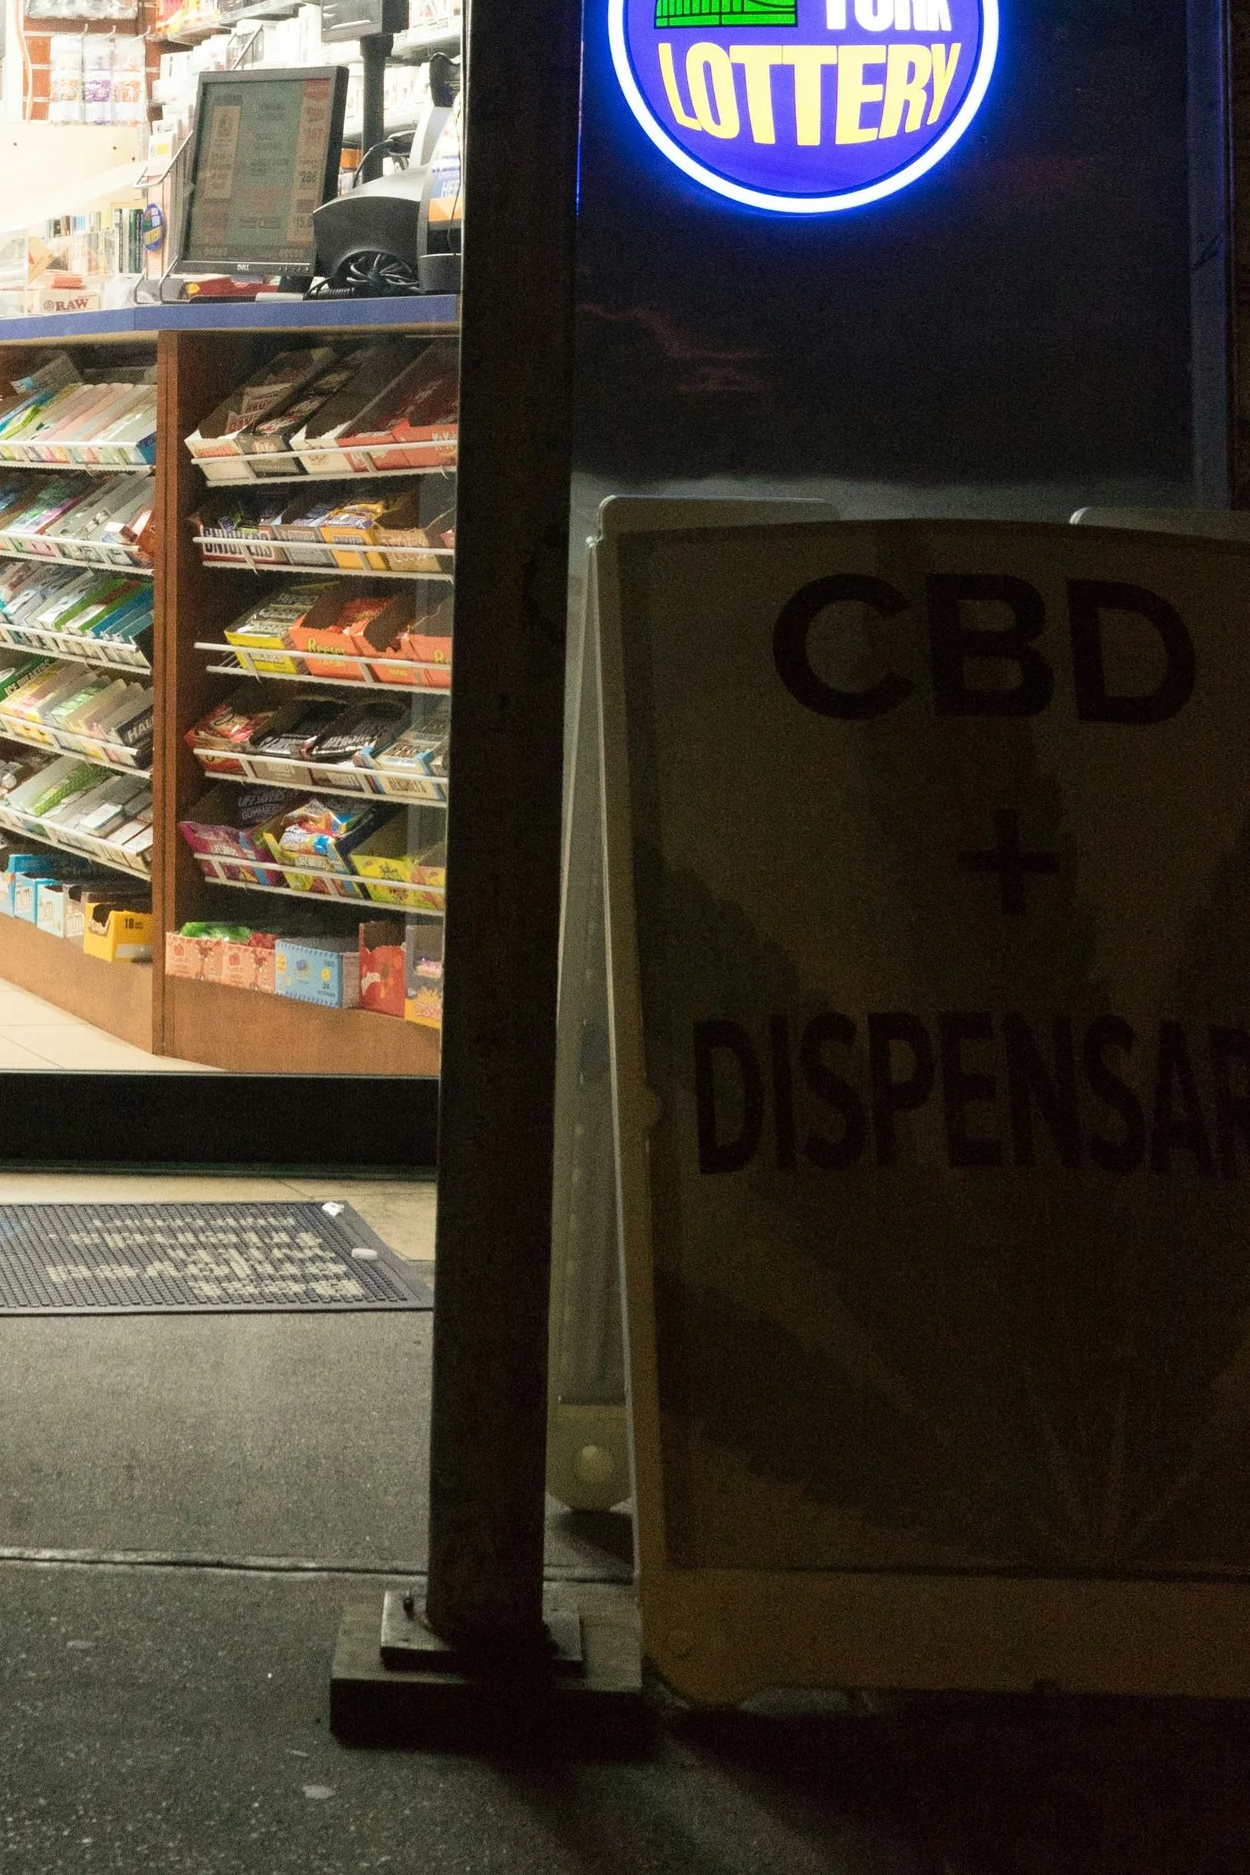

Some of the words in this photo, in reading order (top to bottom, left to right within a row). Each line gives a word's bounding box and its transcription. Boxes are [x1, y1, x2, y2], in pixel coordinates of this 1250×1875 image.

[657, 41, 962, 146] LOTTERY
[55, 298, 89, 312] RAW
[772, 572, 1196, 726] CBD
[123, 917, 134, 929] 18
[693, 1010, 1250, 1182] DISPENSAR
